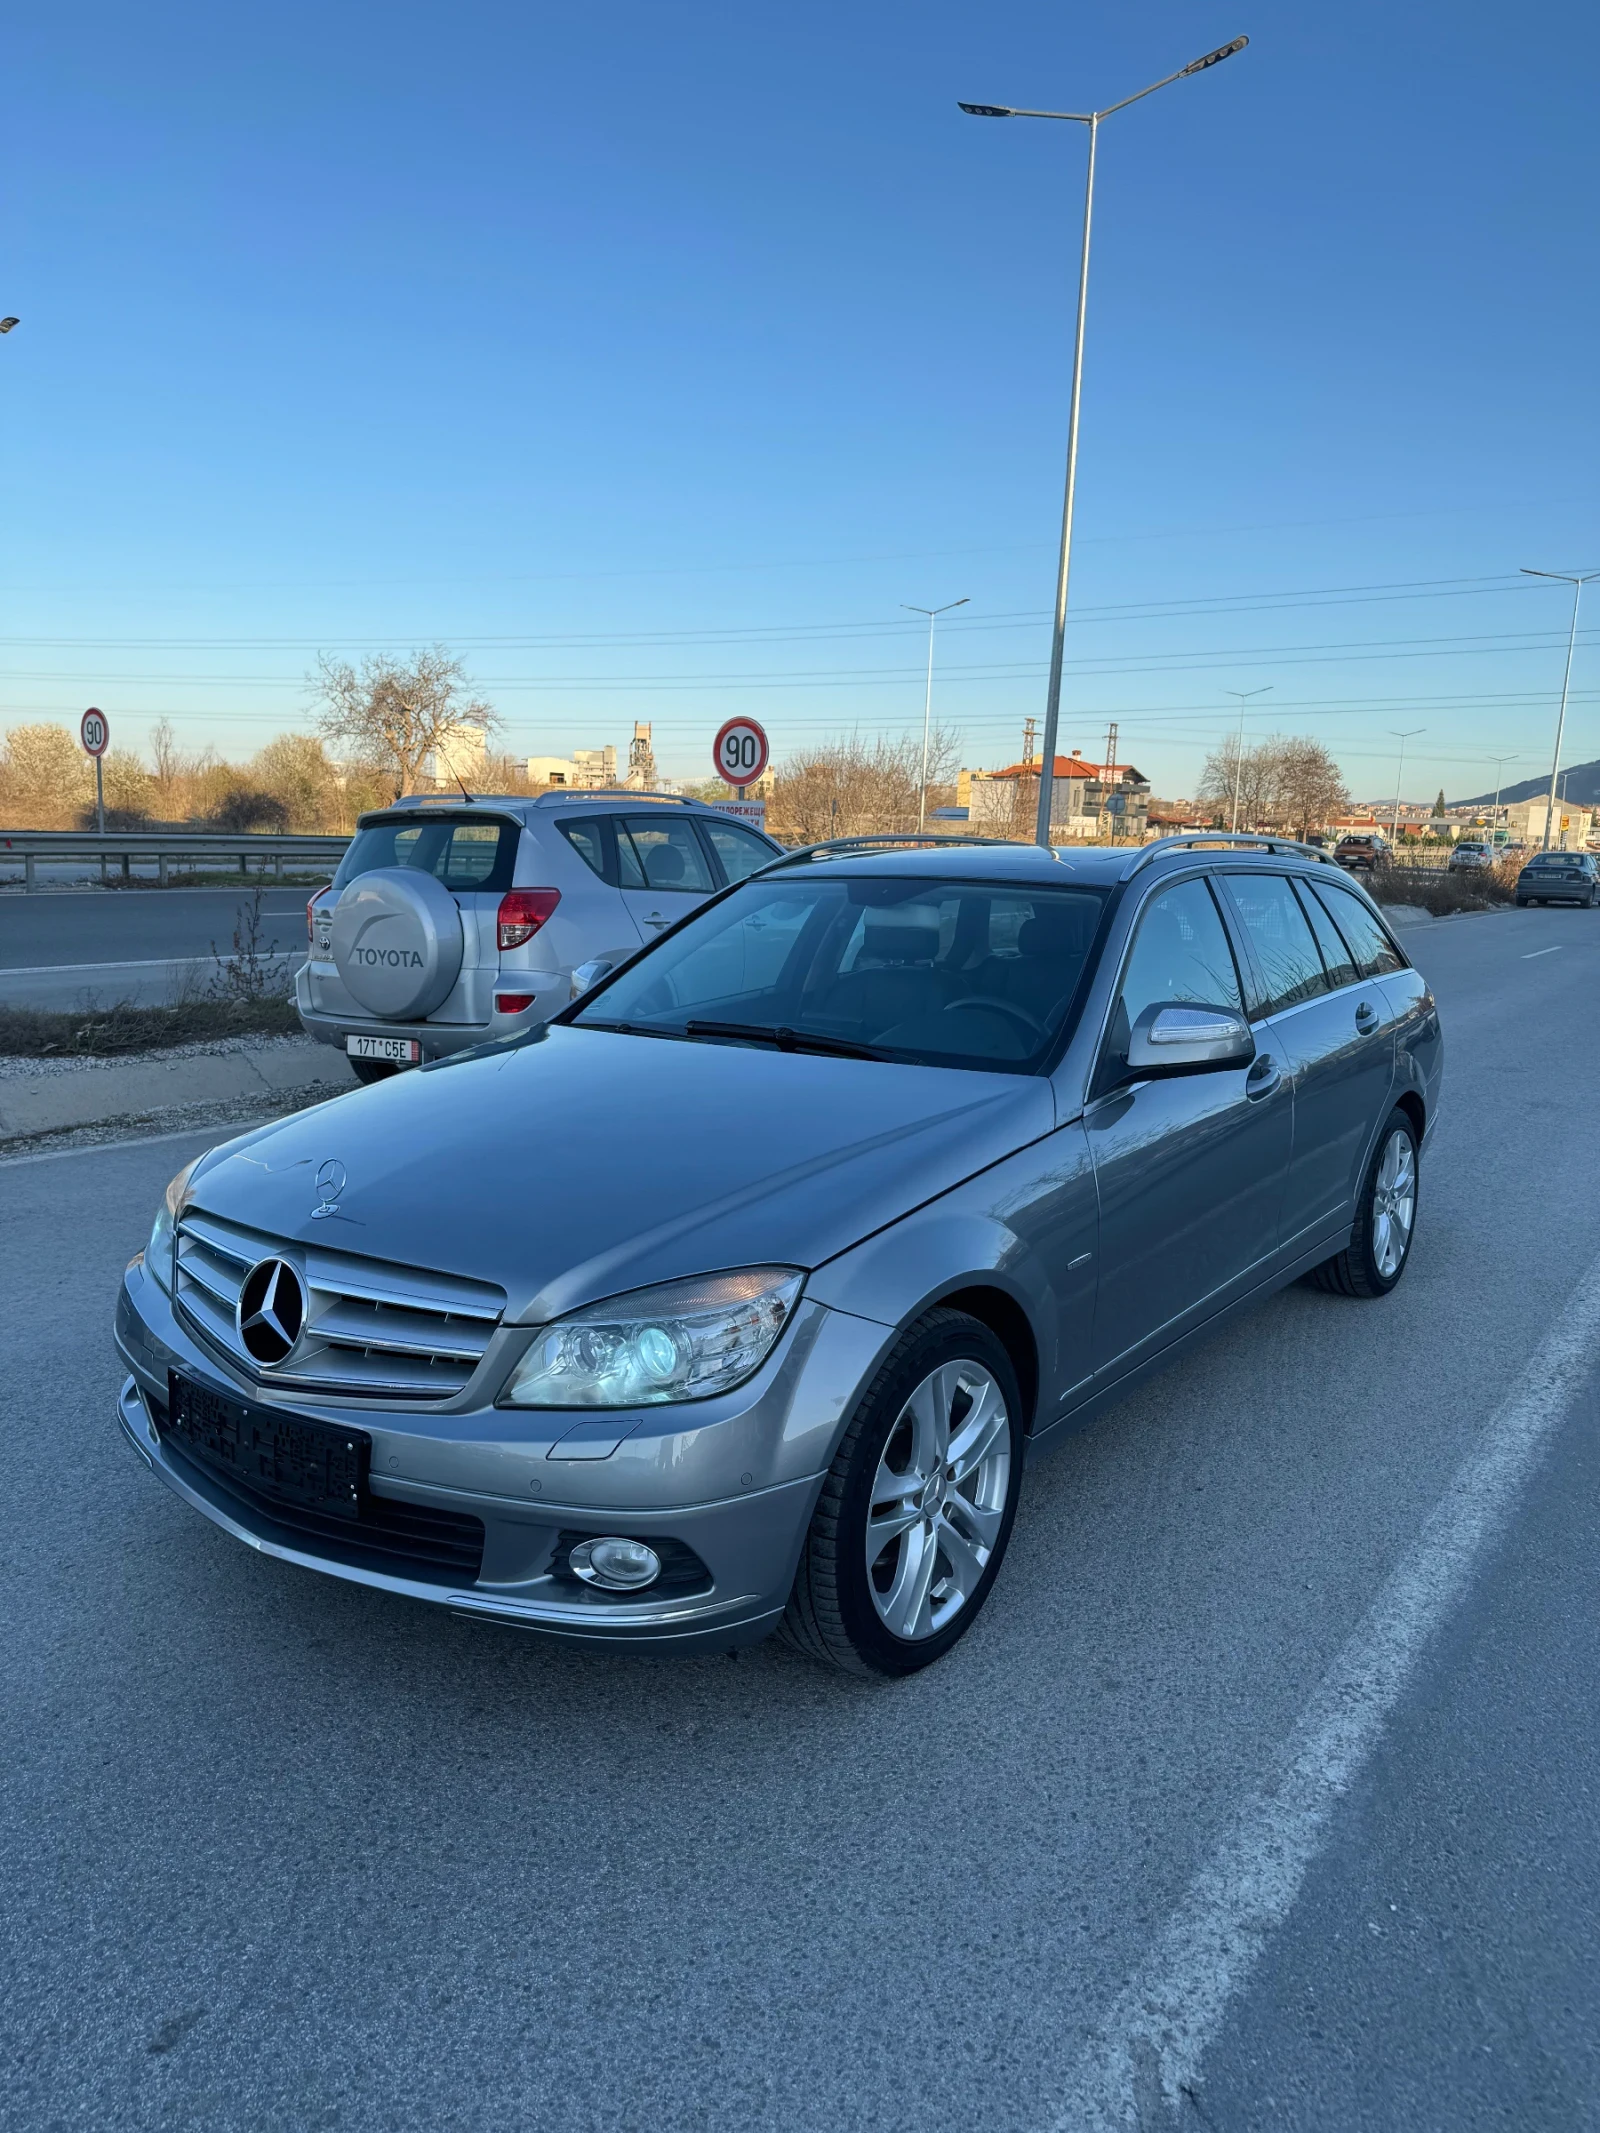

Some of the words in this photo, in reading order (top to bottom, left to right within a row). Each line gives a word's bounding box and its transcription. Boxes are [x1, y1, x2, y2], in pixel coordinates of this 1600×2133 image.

[86, 721, 102, 745] 90
[726, 735, 755, 768] 90
[355, 948, 424, 968] TOYOTA
